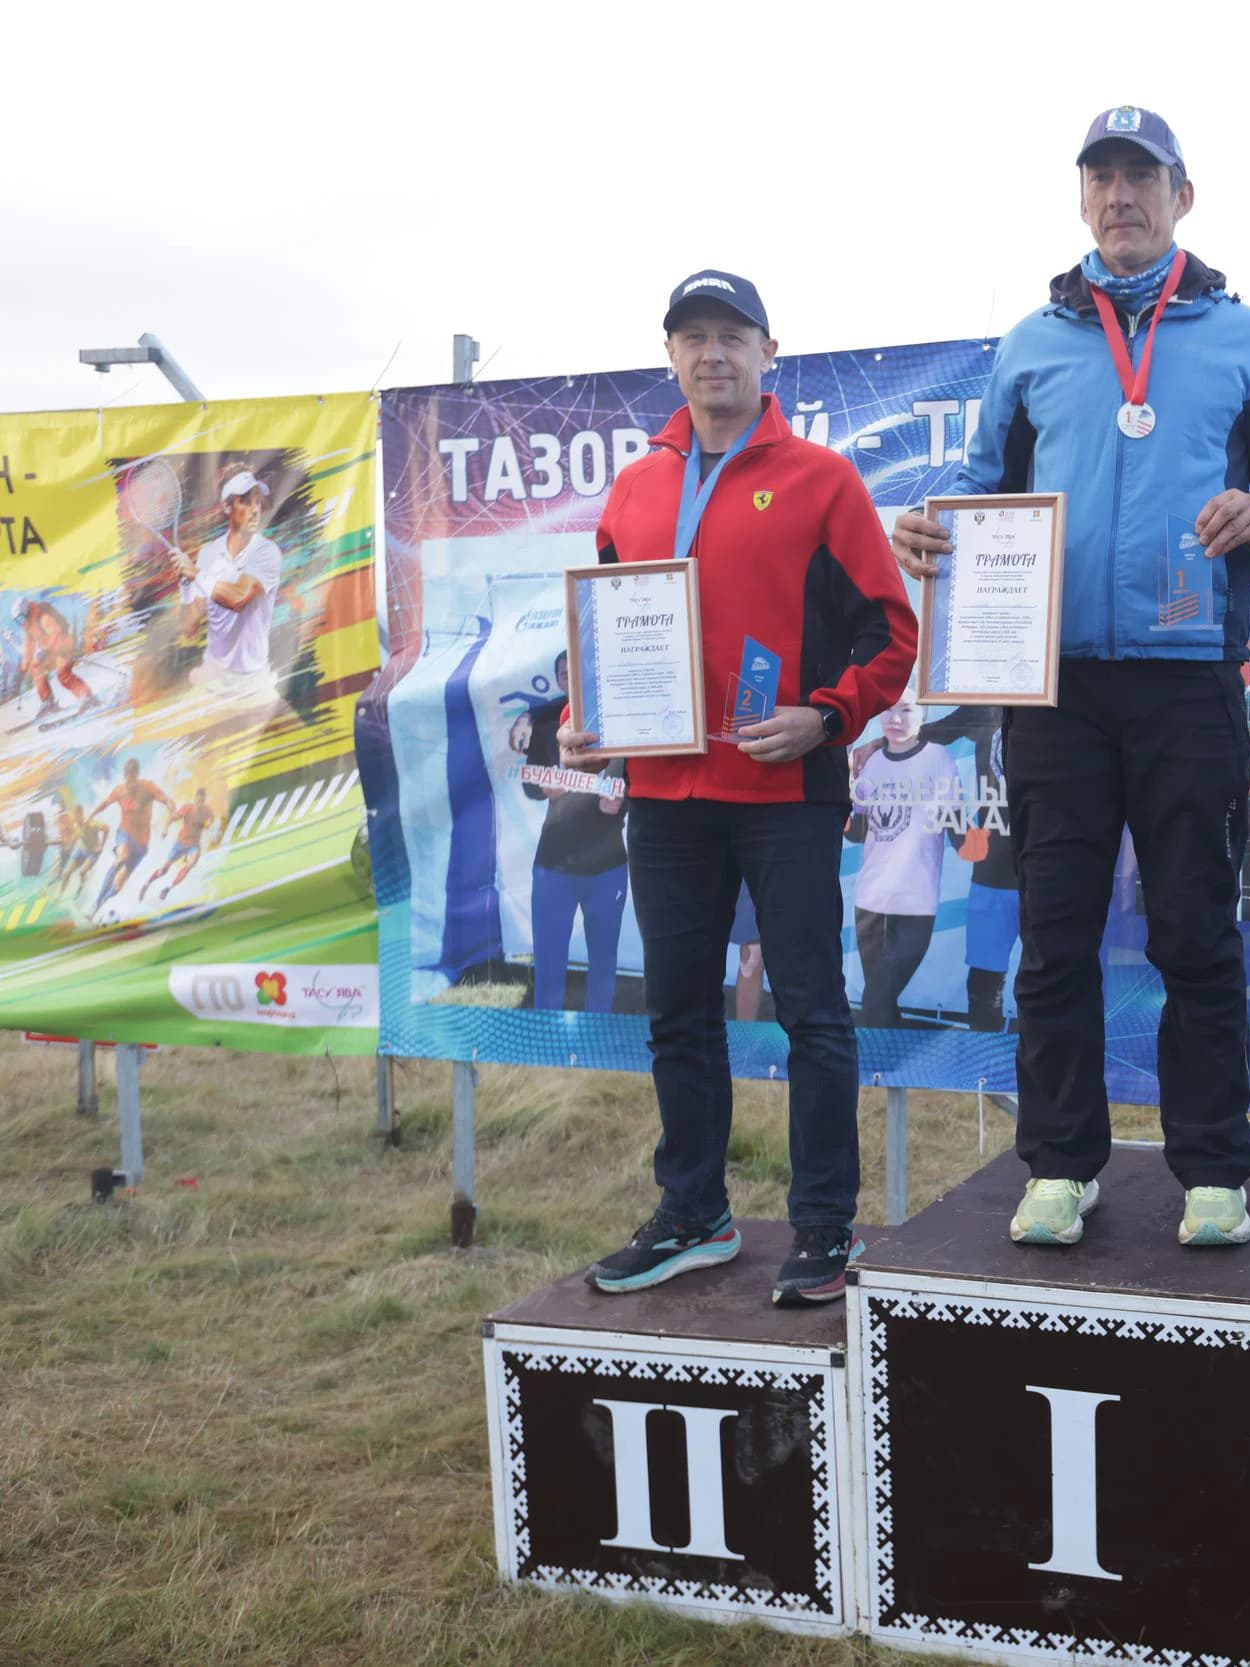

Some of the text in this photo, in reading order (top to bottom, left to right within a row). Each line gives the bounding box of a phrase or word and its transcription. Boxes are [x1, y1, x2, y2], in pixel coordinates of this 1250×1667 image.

[975, 552, 1037, 568] ГРАМОТА
[615, 613, 674, 629] ГРАМОТА
[850, 775, 1009, 807] СЕВЕРНЫ
[923, 803, 1011, 836] ЗАКА
